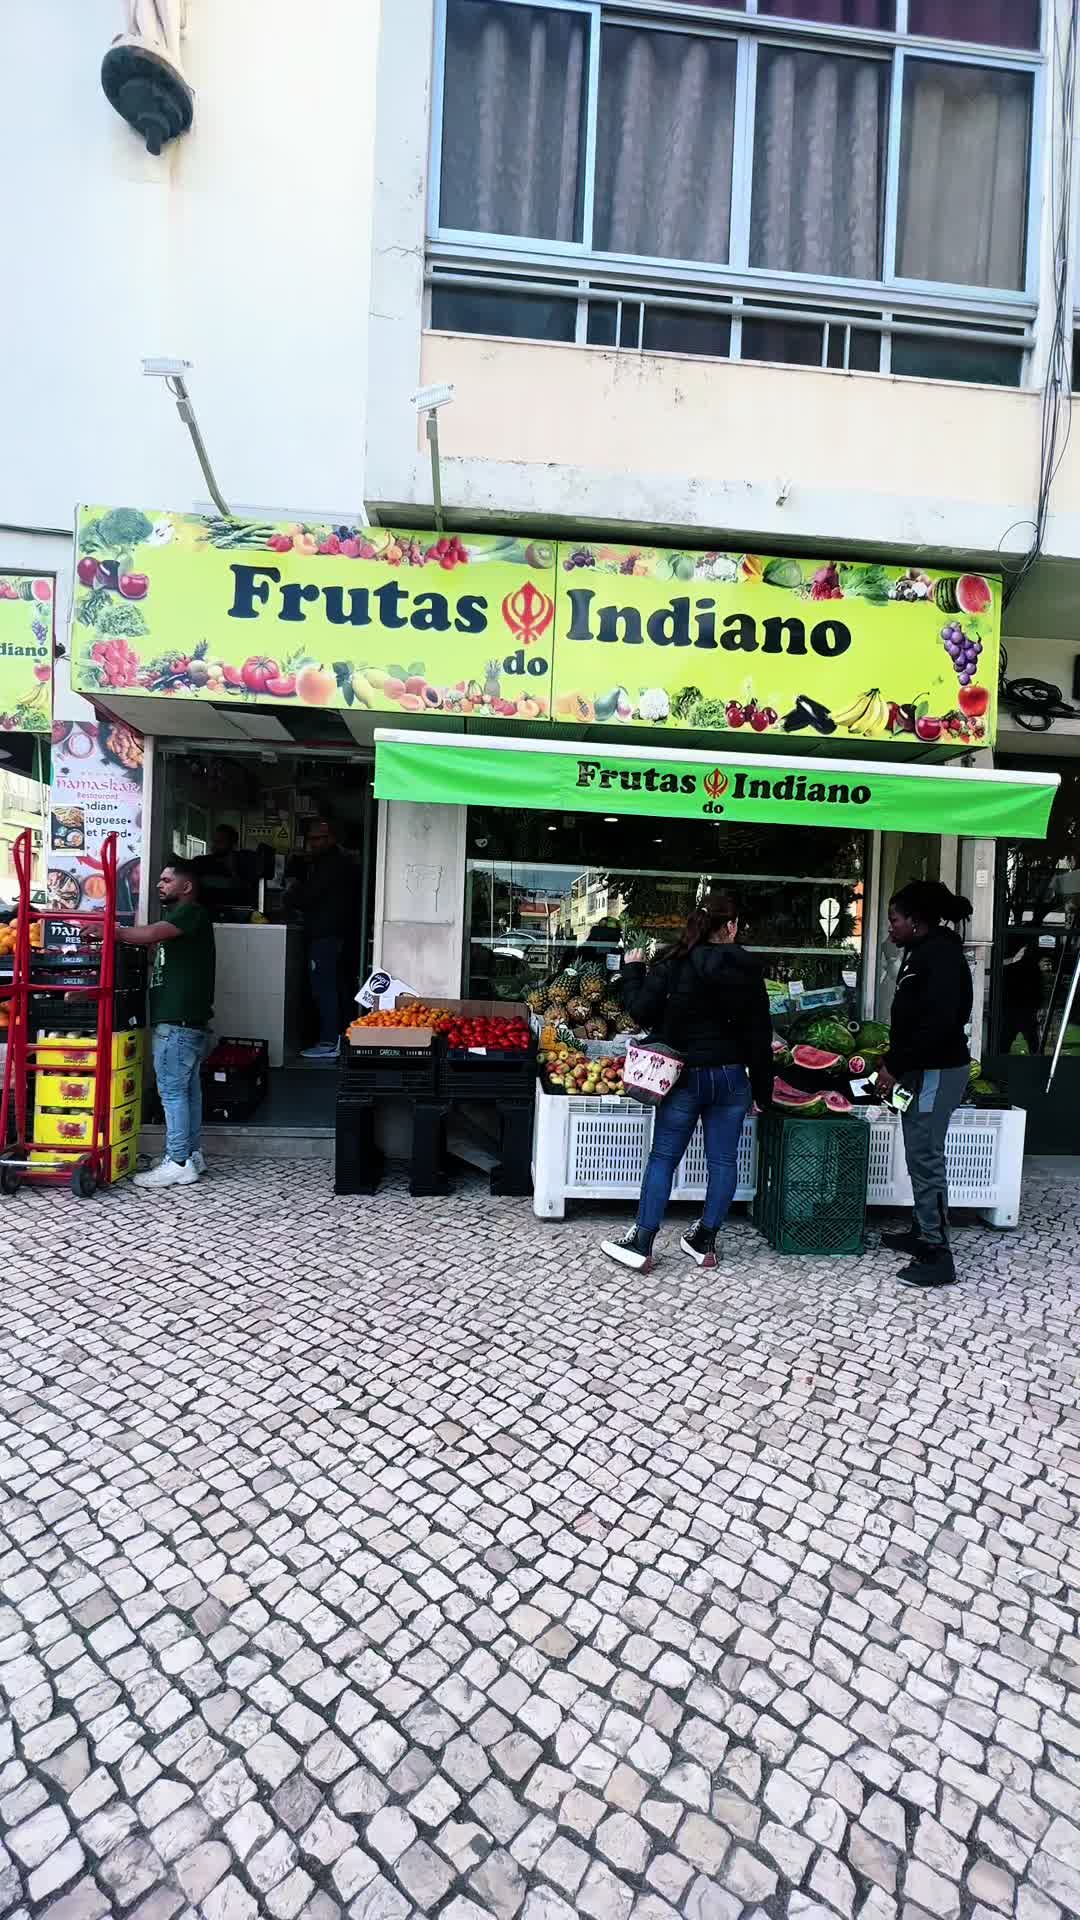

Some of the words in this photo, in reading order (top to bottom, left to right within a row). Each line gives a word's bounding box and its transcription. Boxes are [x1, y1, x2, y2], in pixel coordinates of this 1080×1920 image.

[227, 563, 488, 634] Frutas
[566, 588, 852, 657] Indiano
[503, 648, 549, 677] do
[575, 760, 697, 794] Frutas
[731, 773, 872, 804] Indiano
[86, 801, 113, 811] ndian
[702, 800, 725, 815] do
[86, 816, 127, 826] uguese
